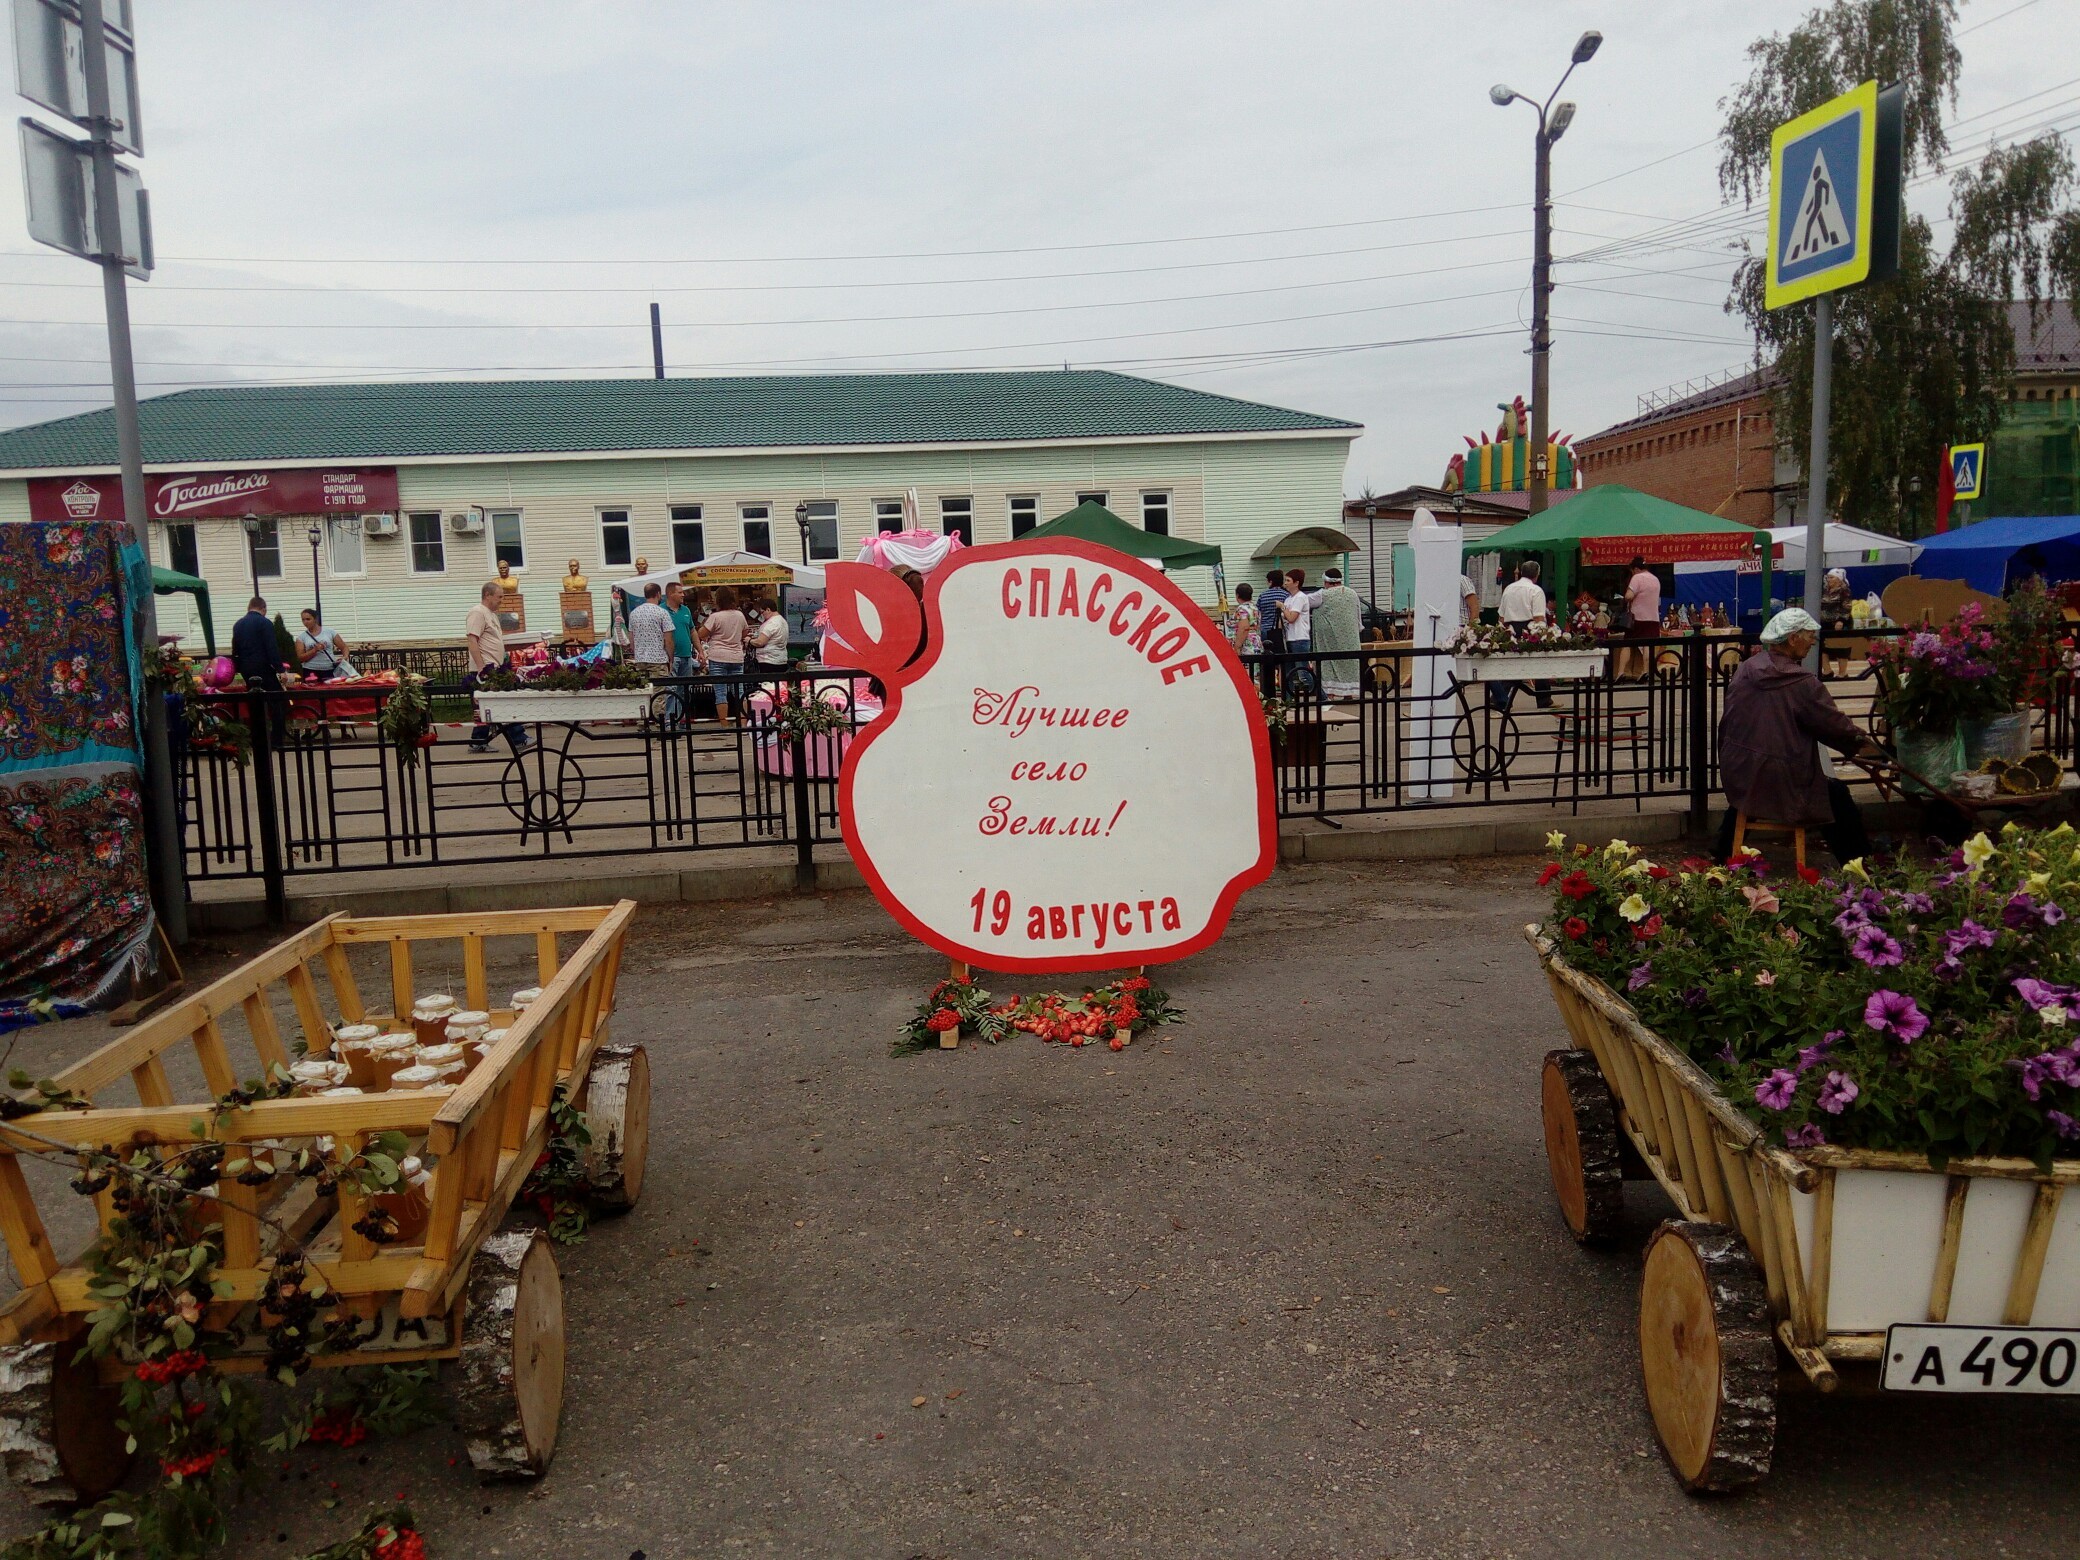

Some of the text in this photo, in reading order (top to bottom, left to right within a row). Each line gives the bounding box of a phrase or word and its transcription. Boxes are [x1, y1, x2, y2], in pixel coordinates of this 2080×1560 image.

[154, 473, 270, 515] Госаптека
[322, 473, 357, 483] СТАНДАРТ
[323, 484, 364, 494] ФАРМАЦИИ
[324, 494, 367, 505] С 1918 ГОДА
[1001, 567, 1212, 686] СПАССКОЕ
[972, 686, 1131, 738] Лучшее
[1010, 761, 1088, 782] село
[978, 796, 1128, 837] Земли!
[970, 888, 1182, 949] 19 августа
